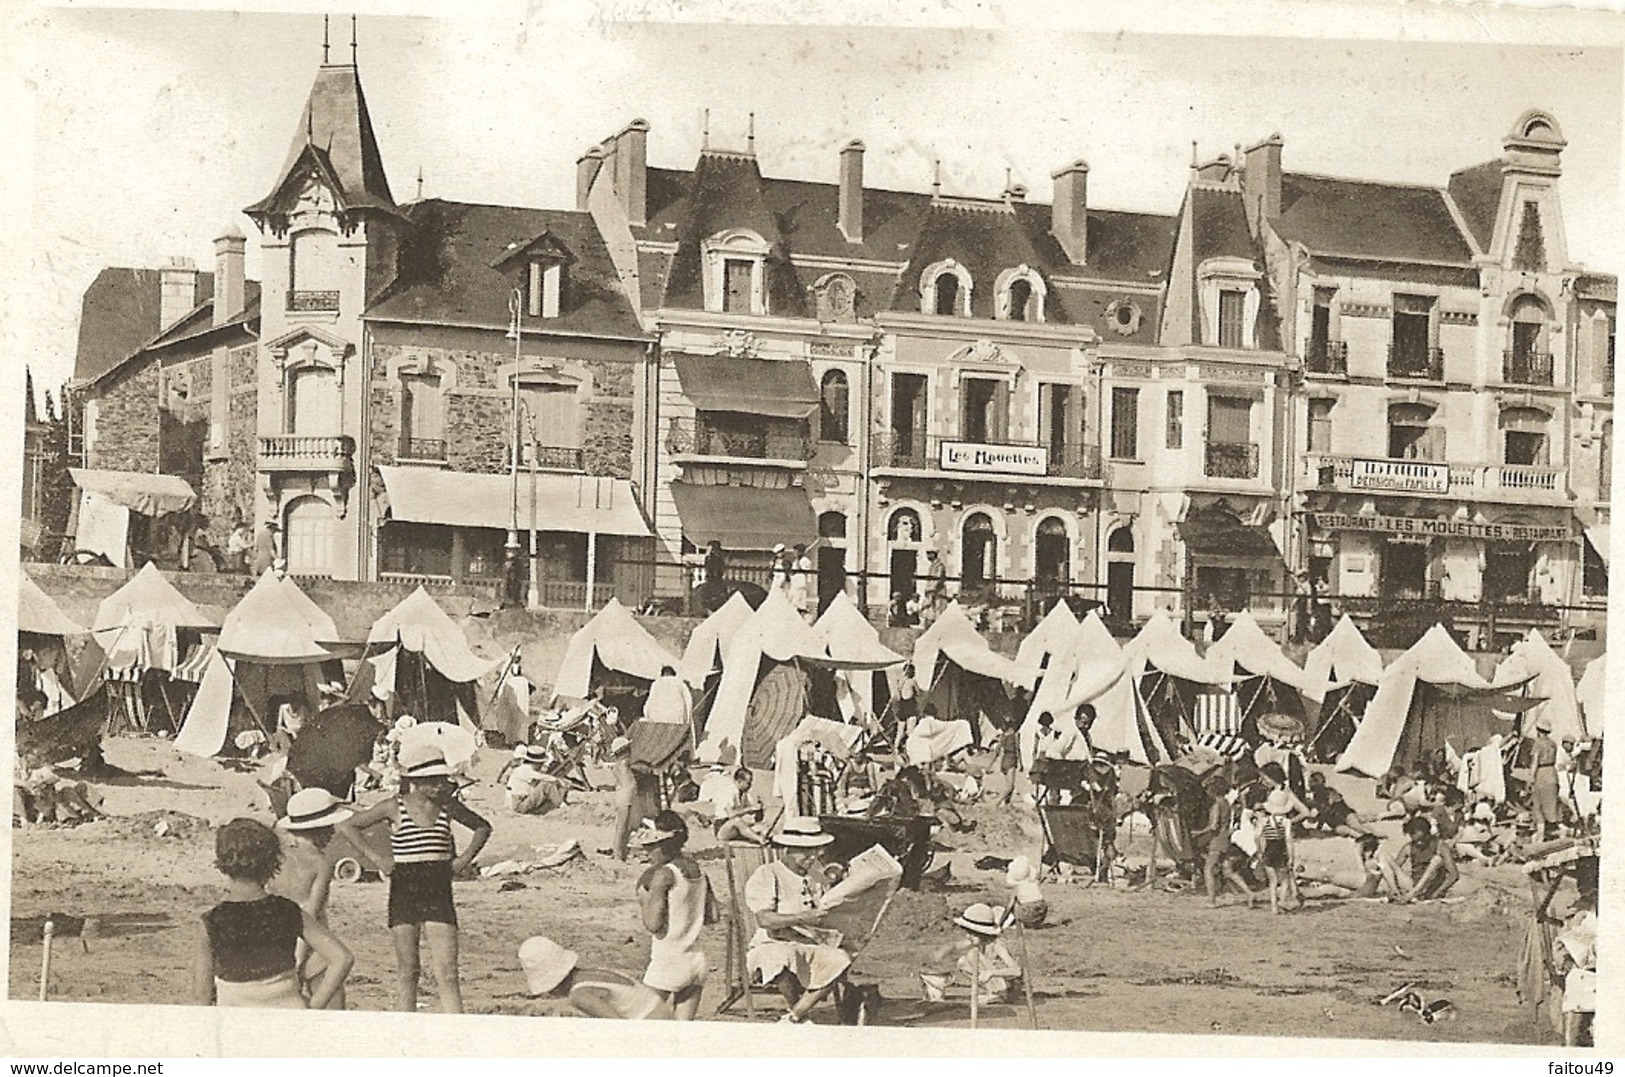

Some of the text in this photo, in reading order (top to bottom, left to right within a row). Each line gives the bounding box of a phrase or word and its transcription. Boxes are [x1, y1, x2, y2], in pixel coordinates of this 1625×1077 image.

[949, 448, 1039, 465] Les Mouettes
[1386, 519, 1413, 531] LES
[1423, 521, 1502, 537] MOUETTES
